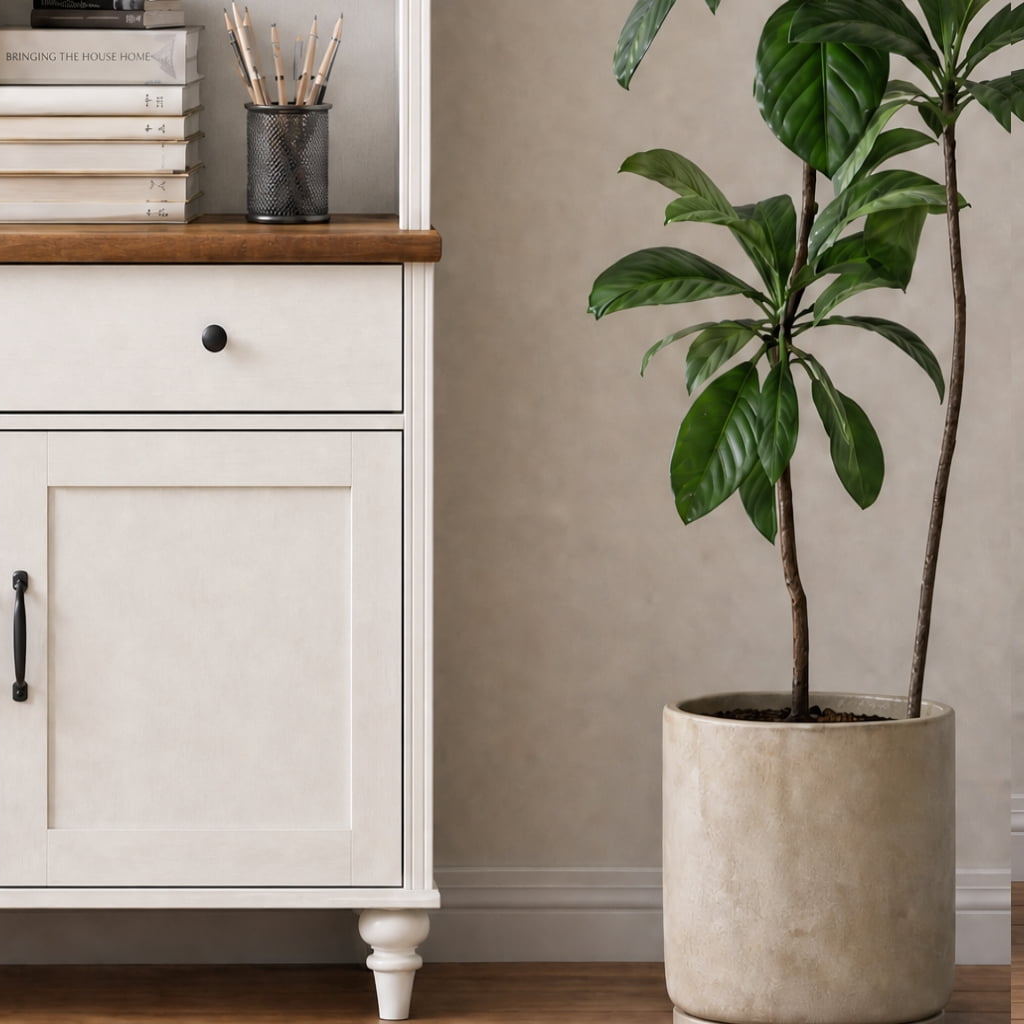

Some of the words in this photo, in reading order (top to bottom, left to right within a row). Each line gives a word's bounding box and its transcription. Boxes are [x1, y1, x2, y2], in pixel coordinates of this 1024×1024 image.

[5, 51, 57, 62] BRINGING
[59, 51, 79, 62] THE
[82, 51, 117, 62] HOUSE
[120, 51, 151, 62] HOME
